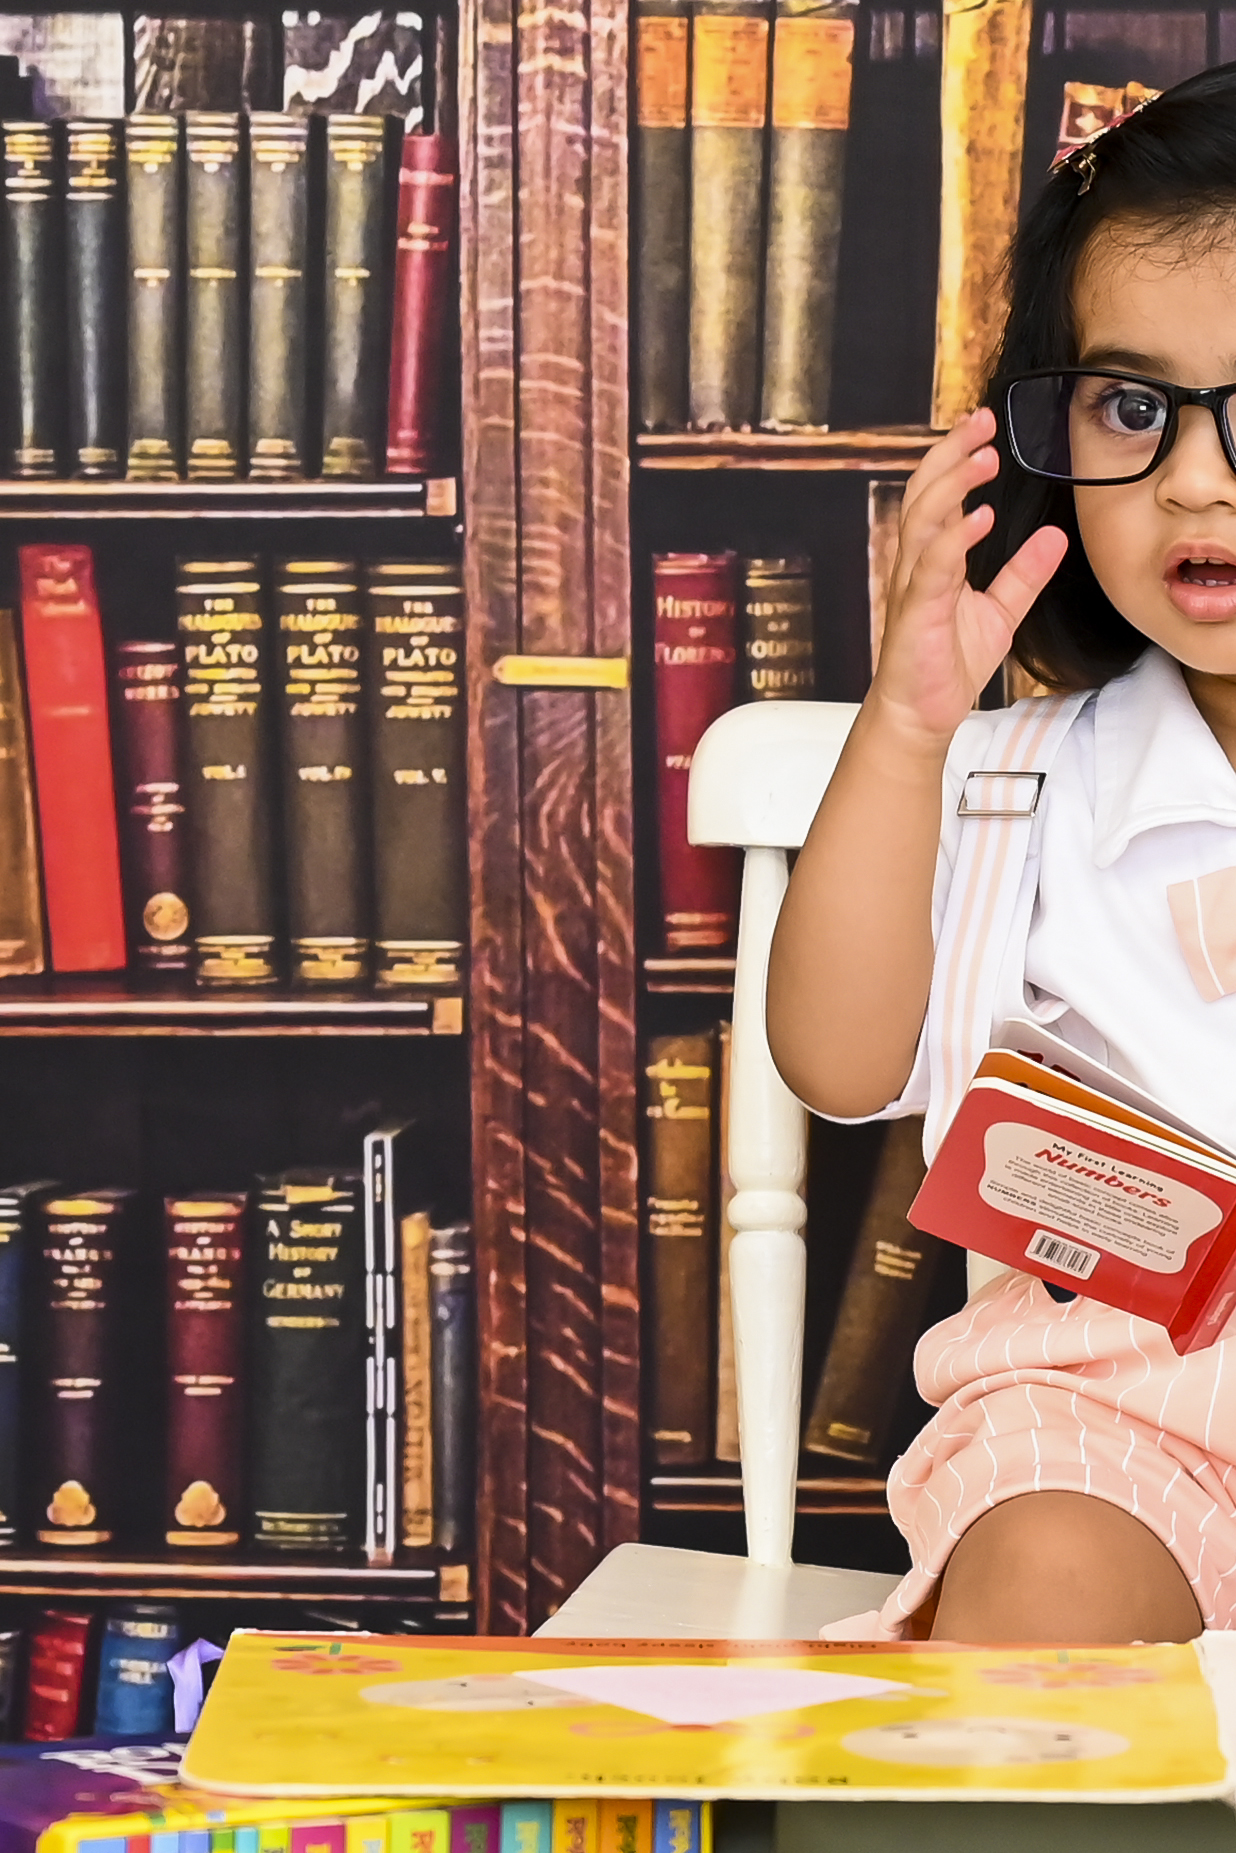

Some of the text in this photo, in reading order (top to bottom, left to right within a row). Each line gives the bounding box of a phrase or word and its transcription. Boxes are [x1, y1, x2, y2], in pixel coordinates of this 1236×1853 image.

[185, 644, 259, 665] PLATO
[286, 643, 360, 665] PLATO
[382, 647, 458, 667] PLATO
[1034, 1148, 1173, 1208] Numbers
[1052, 1142, 1165, 1193] My First Learning
[262, 1277, 345, 1300] GERMANY
